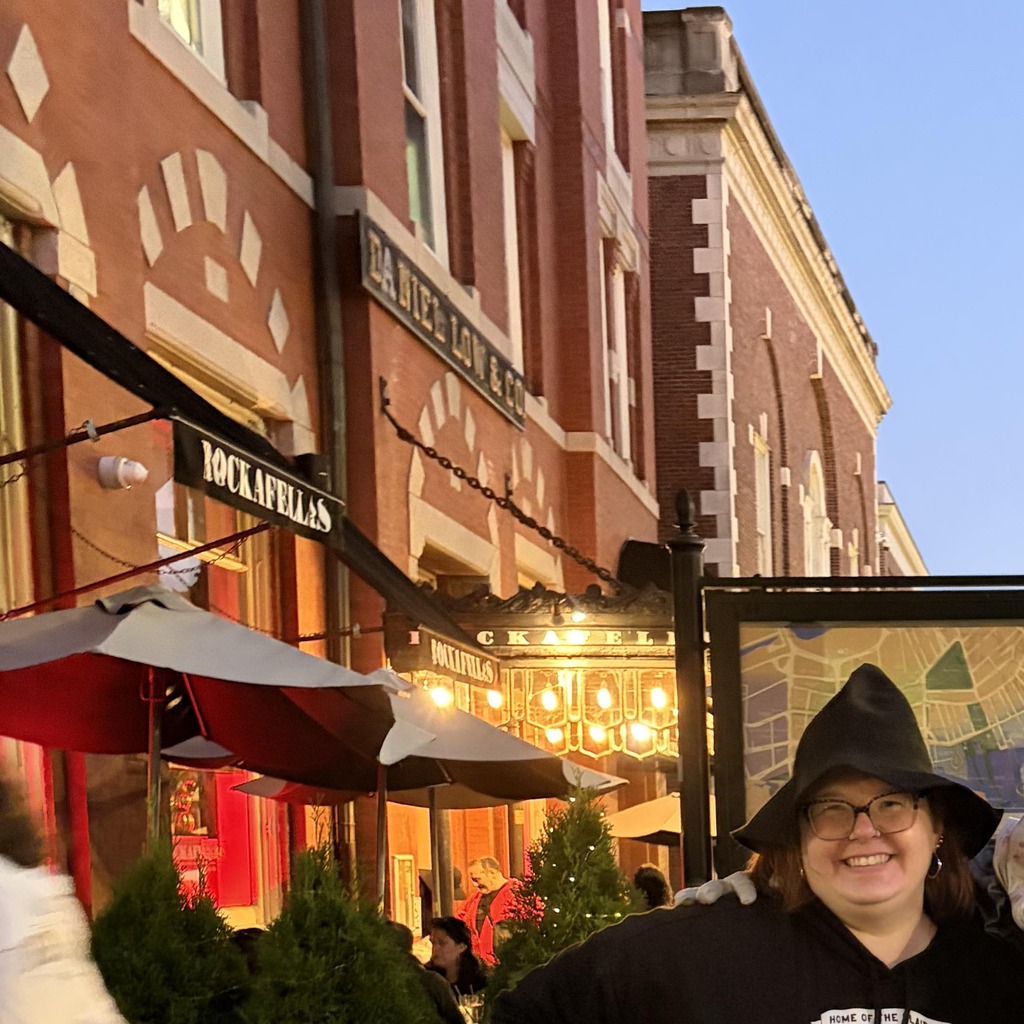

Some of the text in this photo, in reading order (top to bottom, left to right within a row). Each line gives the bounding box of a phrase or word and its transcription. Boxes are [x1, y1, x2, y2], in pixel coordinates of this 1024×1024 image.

[367, 228, 446, 344] DANIEL
[451, 314, 486, 381] LOW
[489, 355, 503, 397] &
[201, 440, 332, 533] ROCKAFELLAS
[829, 1013, 857, 1024] HOME
[861, 1013, 874, 1022] OF
[881, 1013, 899, 1022] HE
